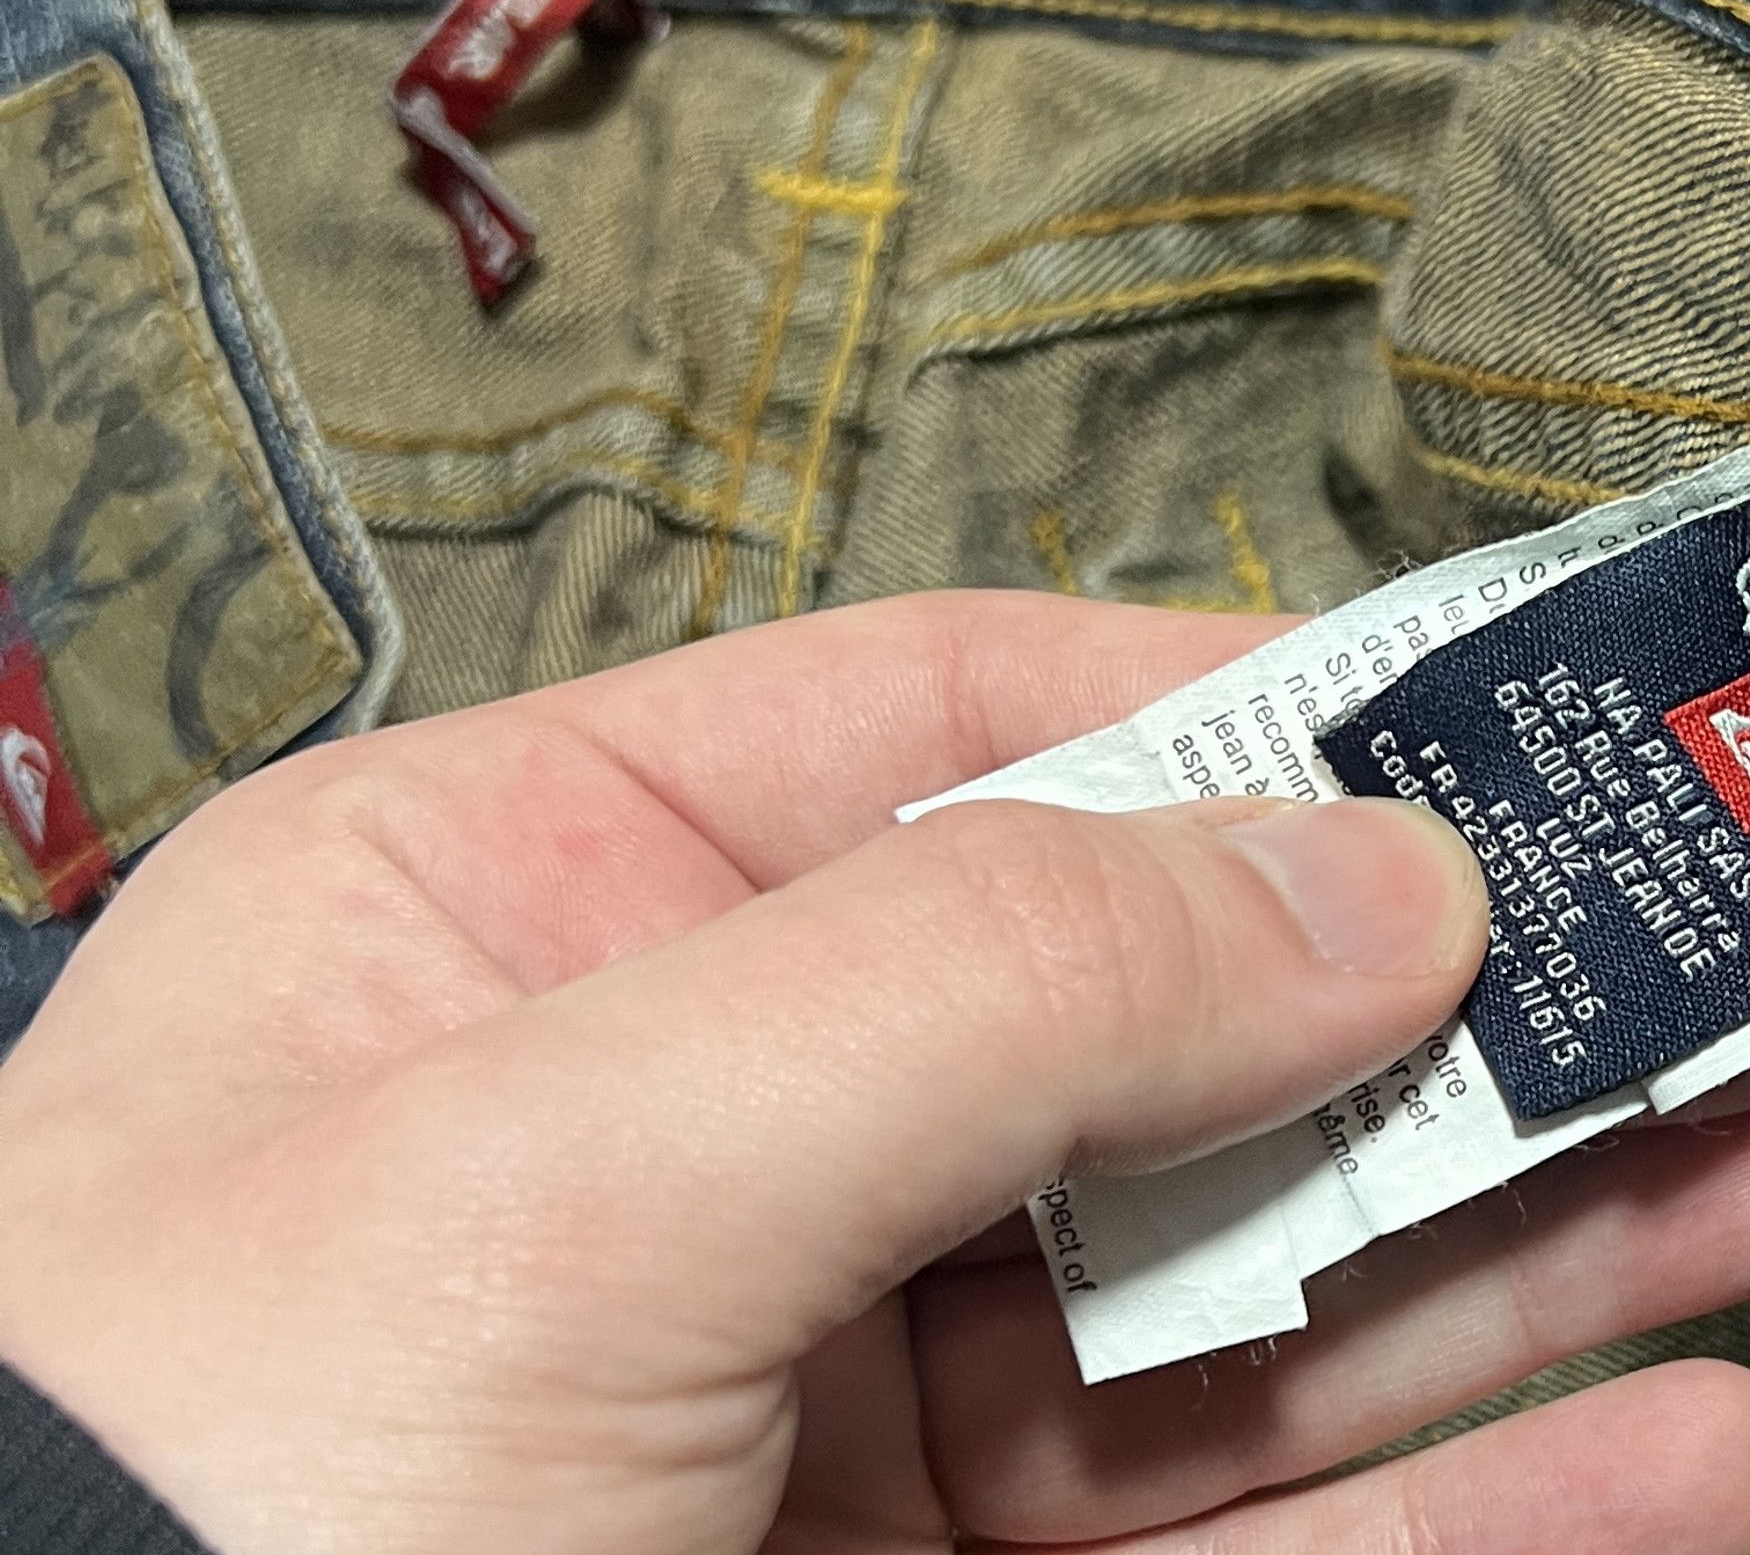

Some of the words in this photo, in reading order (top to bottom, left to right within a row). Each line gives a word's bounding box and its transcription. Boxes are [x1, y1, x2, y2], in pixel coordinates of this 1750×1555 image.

[1285, 673, 1327, 734] n'es
[1325, 652, 1358, 686] Si
[1248, 694, 1319, 805] recomm
[1495, 681, 1581, 795] 64500
[1564, 794, 1615, 838] ST
[1599, 848, 1681, 929] JEAN
[1539, 662, 1590, 729] 162
[1575, 731, 1630, 798] Rue
[1626, 801, 1740, 952] Belharra
[1594, 678, 1642, 734] NA
[1629, 739, 1707, 821] PALI
[1420, 741, 1457, 793] FR
[1452, 796, 1606, 1020] 42331377036
[1489, 800, 1587, 932] FRANCE
[1537, 818, 1591, 880] LUZ
[1173, 735, 1220, 799] aspe
[1346, 1077, 1394, 1143] rise.
[1201, 710, 1252, 775] jean
[1244, 775, 1271, 798] à
[1395, 1077, 1439, 1130] cet
[1513, 975, 1586, 1070] 11615
[1039, 1178, 1086, 1257] pect
[1062, 1262, 1098, 1294] of
